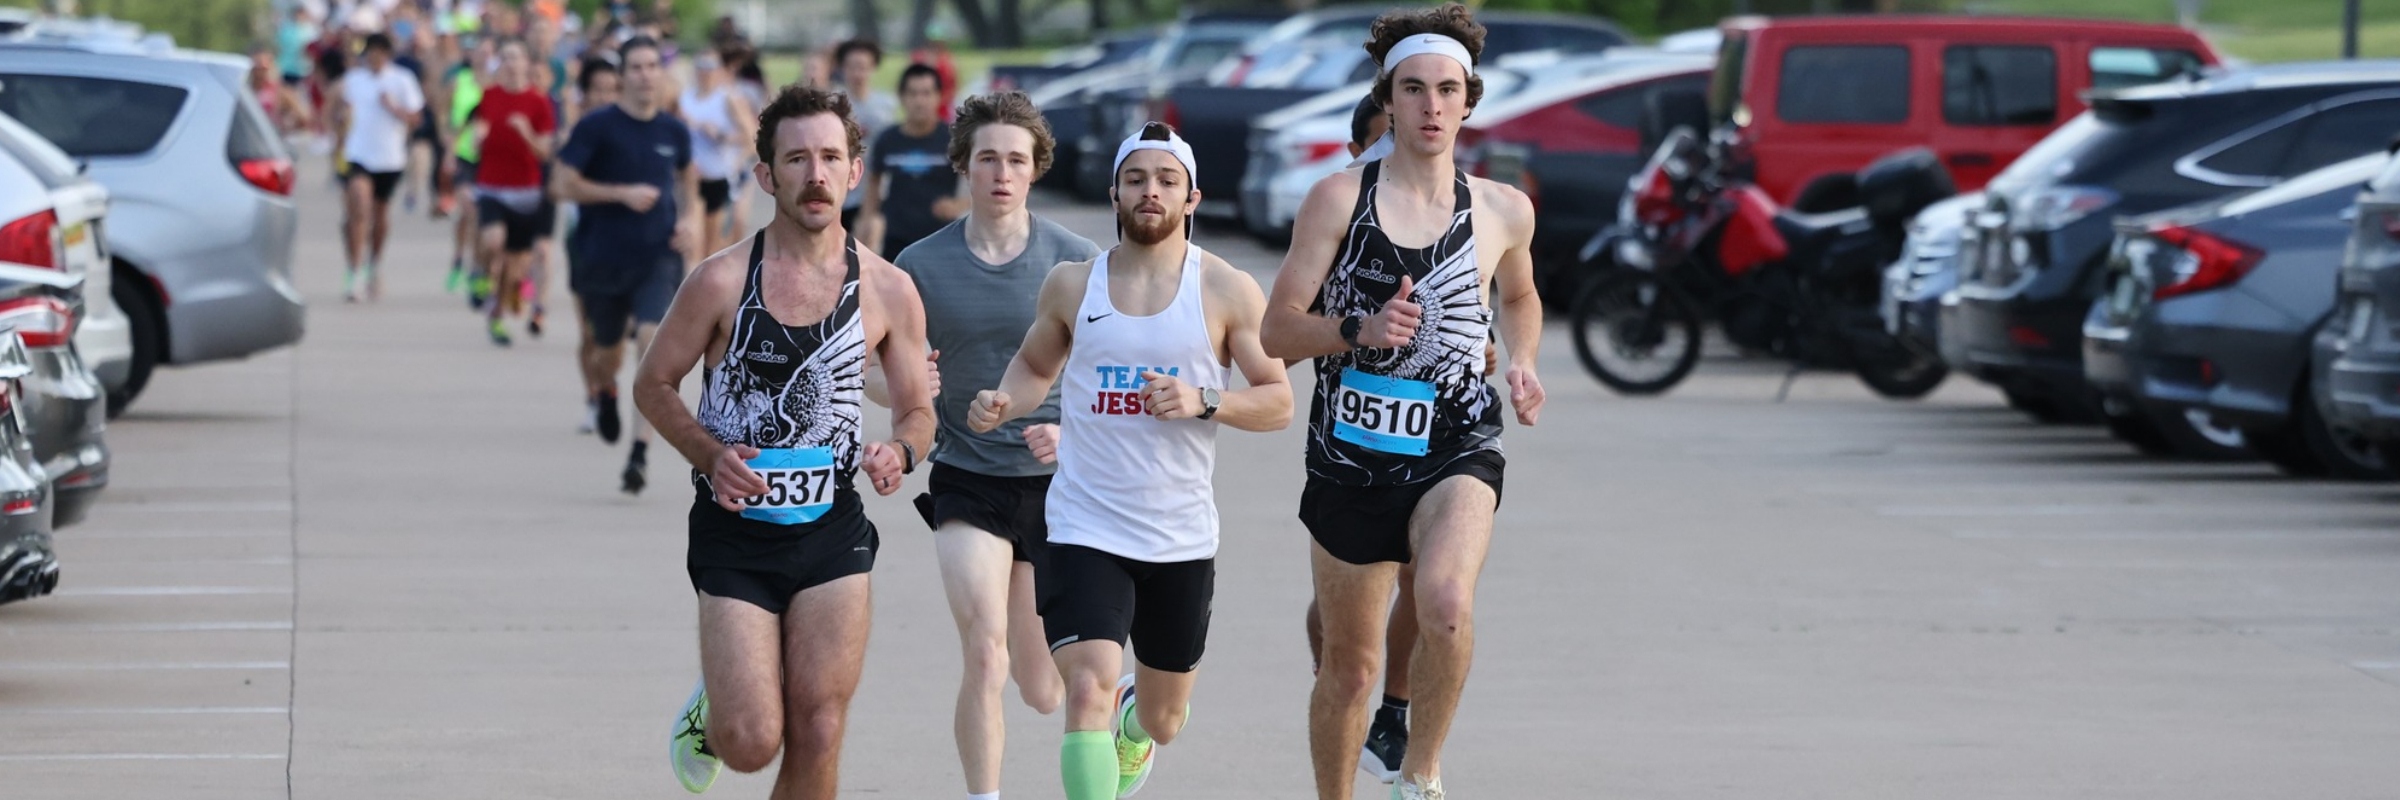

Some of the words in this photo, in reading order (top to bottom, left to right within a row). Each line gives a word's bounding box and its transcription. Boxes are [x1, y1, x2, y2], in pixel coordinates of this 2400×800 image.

[1356, 267, 1396, 284] NOMAD
[748, 351, 788, 364] NOMAD
[1341, 390, 1428, 436] 9510
